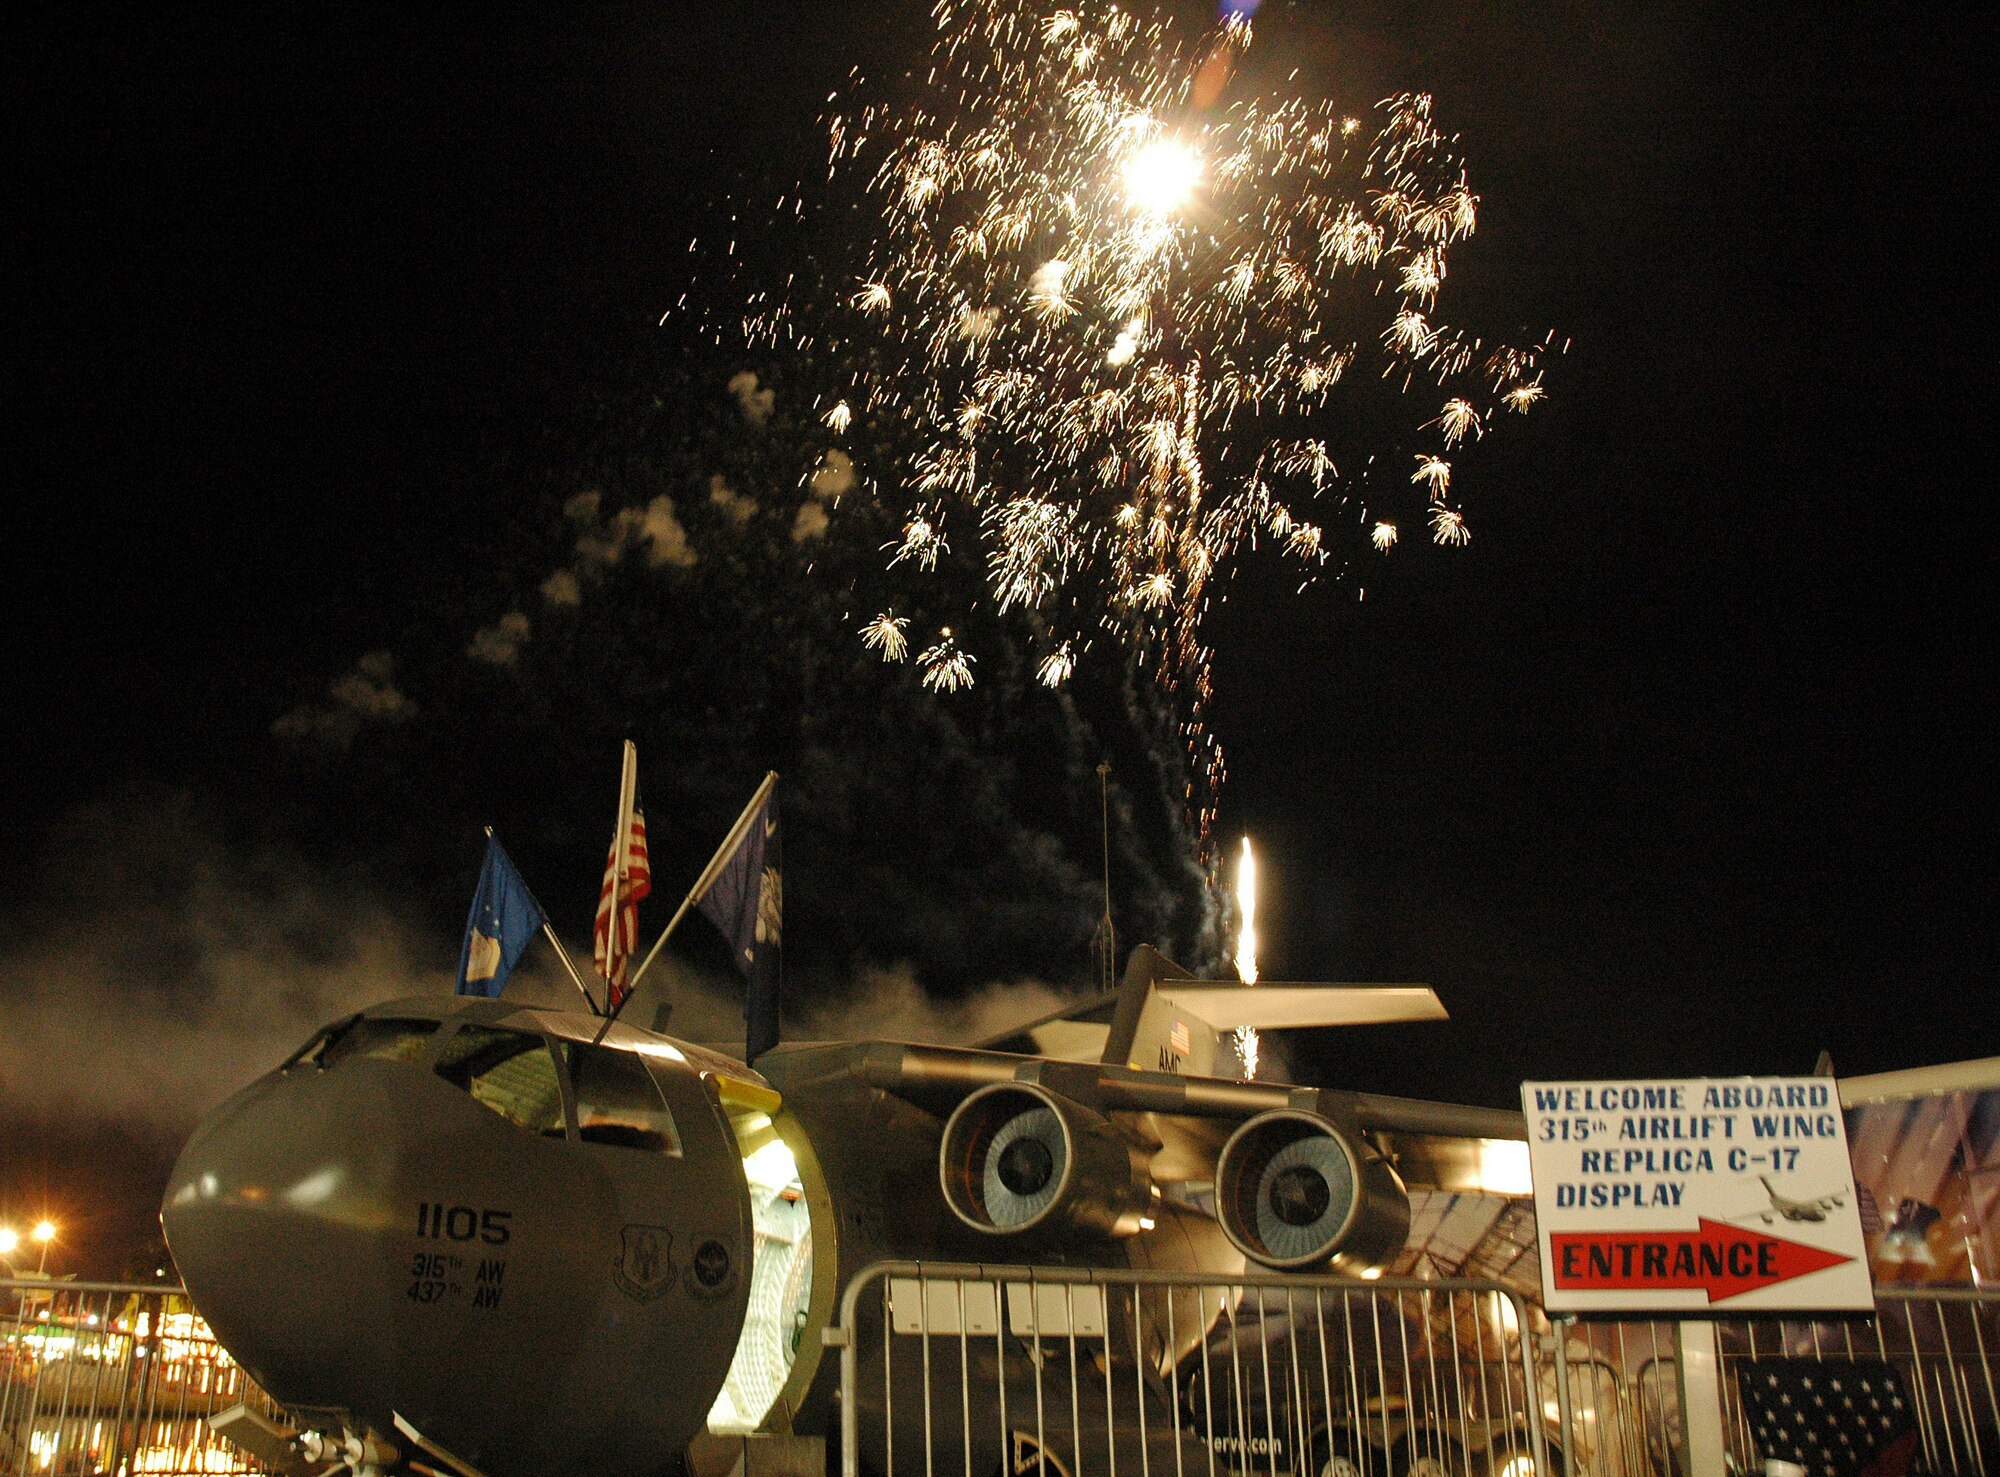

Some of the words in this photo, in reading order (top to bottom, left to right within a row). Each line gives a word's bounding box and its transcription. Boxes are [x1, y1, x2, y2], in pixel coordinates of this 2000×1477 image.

[1159, 1045, 1181, 1076] AMC
[1535, 1086, 1687, 1112] WELCOME
[1702, 1084, 1830, 1109] ABOARD
[1538, 1117, 1607, 1142] 315th
[1619, 1115, 1738, 1139] AIRLIFT
[1752, 1113, 1836, 1138] WING
[1582, 1148, 1714, 1174] REPLICA
[1728, 1148, 1801, 1172] C-17
[1557, 1182, 1686, 1208] DISPLAY
[417, 1202, 513, 1245] 1105
[476, 1260, 506, 1285] AW
[1562, 1242, 1780, 1280] ENTRANCE
[473, 1286, 502, 1309] AW
